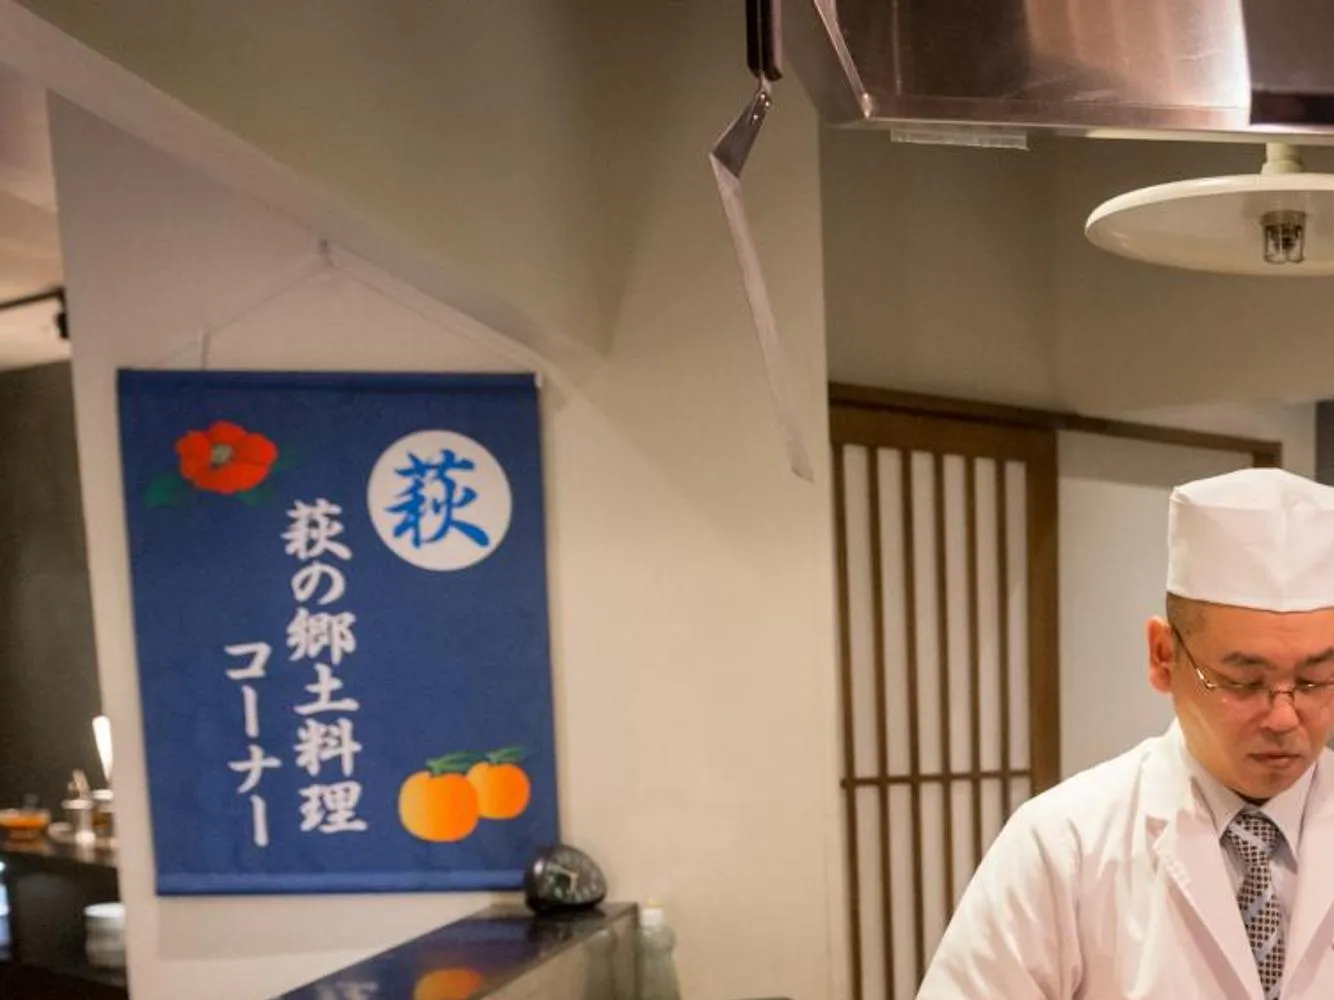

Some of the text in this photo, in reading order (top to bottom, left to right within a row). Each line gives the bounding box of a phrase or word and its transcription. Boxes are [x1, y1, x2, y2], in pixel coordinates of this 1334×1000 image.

[386, 448, 490, 550] 萩
[224, 641, 282, 848] コーナー
[280, 498, 369, 834] 萩の郷土料理
